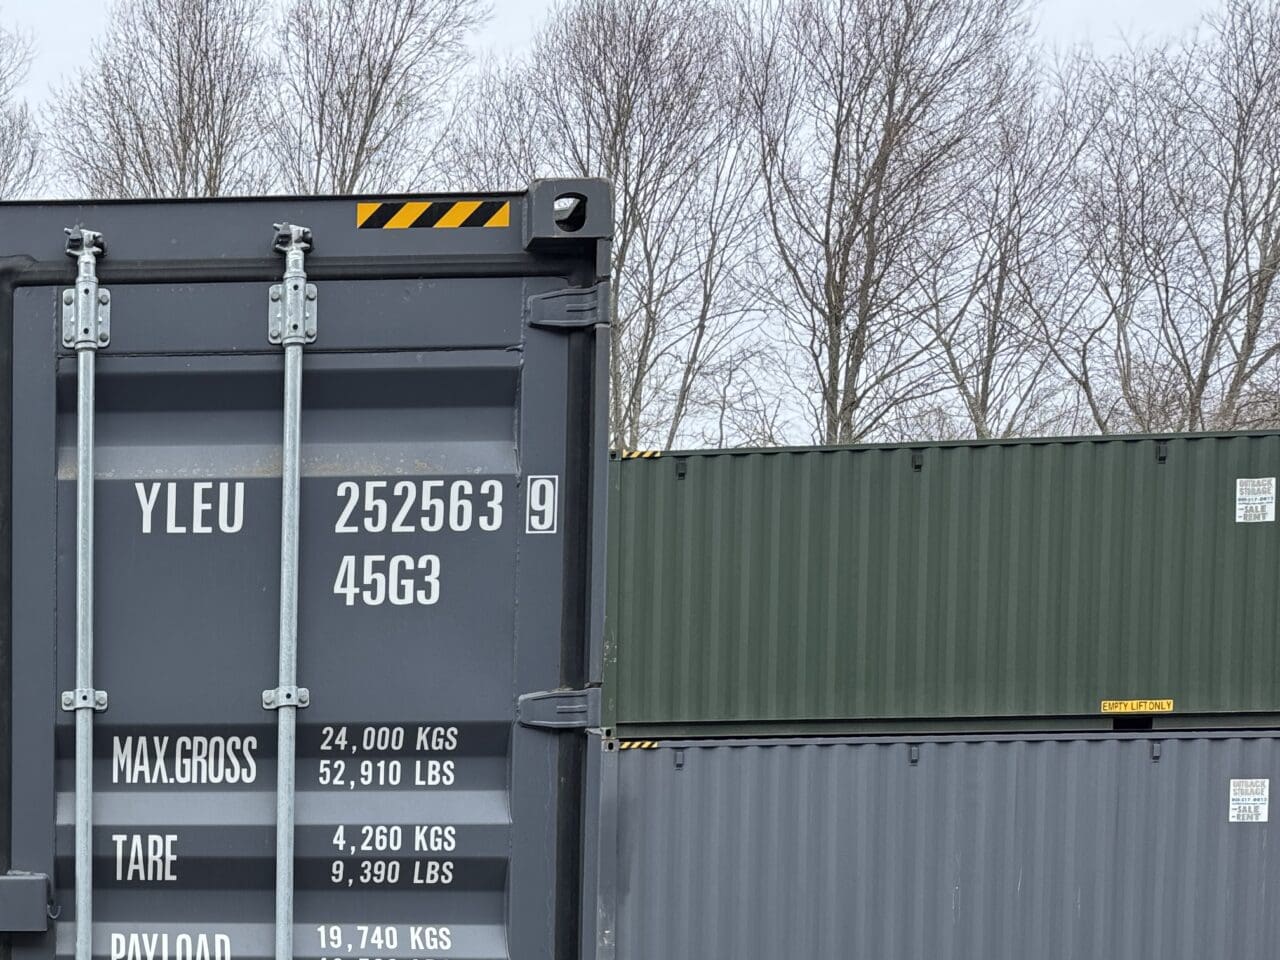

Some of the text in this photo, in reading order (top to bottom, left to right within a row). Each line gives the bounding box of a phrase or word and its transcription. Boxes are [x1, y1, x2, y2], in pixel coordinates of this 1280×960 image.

[135, 477, 554, 534] YLEU 252563 9
[334, 554, 440, 606] 45G3
[1103, 701, 1172, 711] EMPTY LIFT ONLY
[113, 726, 458, 785] MAX.GROSS 24,000 KGS
[318, 760, 455, 790] 52,910 LBS
[112, 825, 456, 881] TARE 4,260 KGS
[330, 860, 453, 887] 9,390 LBS
[317, 925, 398, 953] 19,740
[410, 926, 452, 950] KGS
